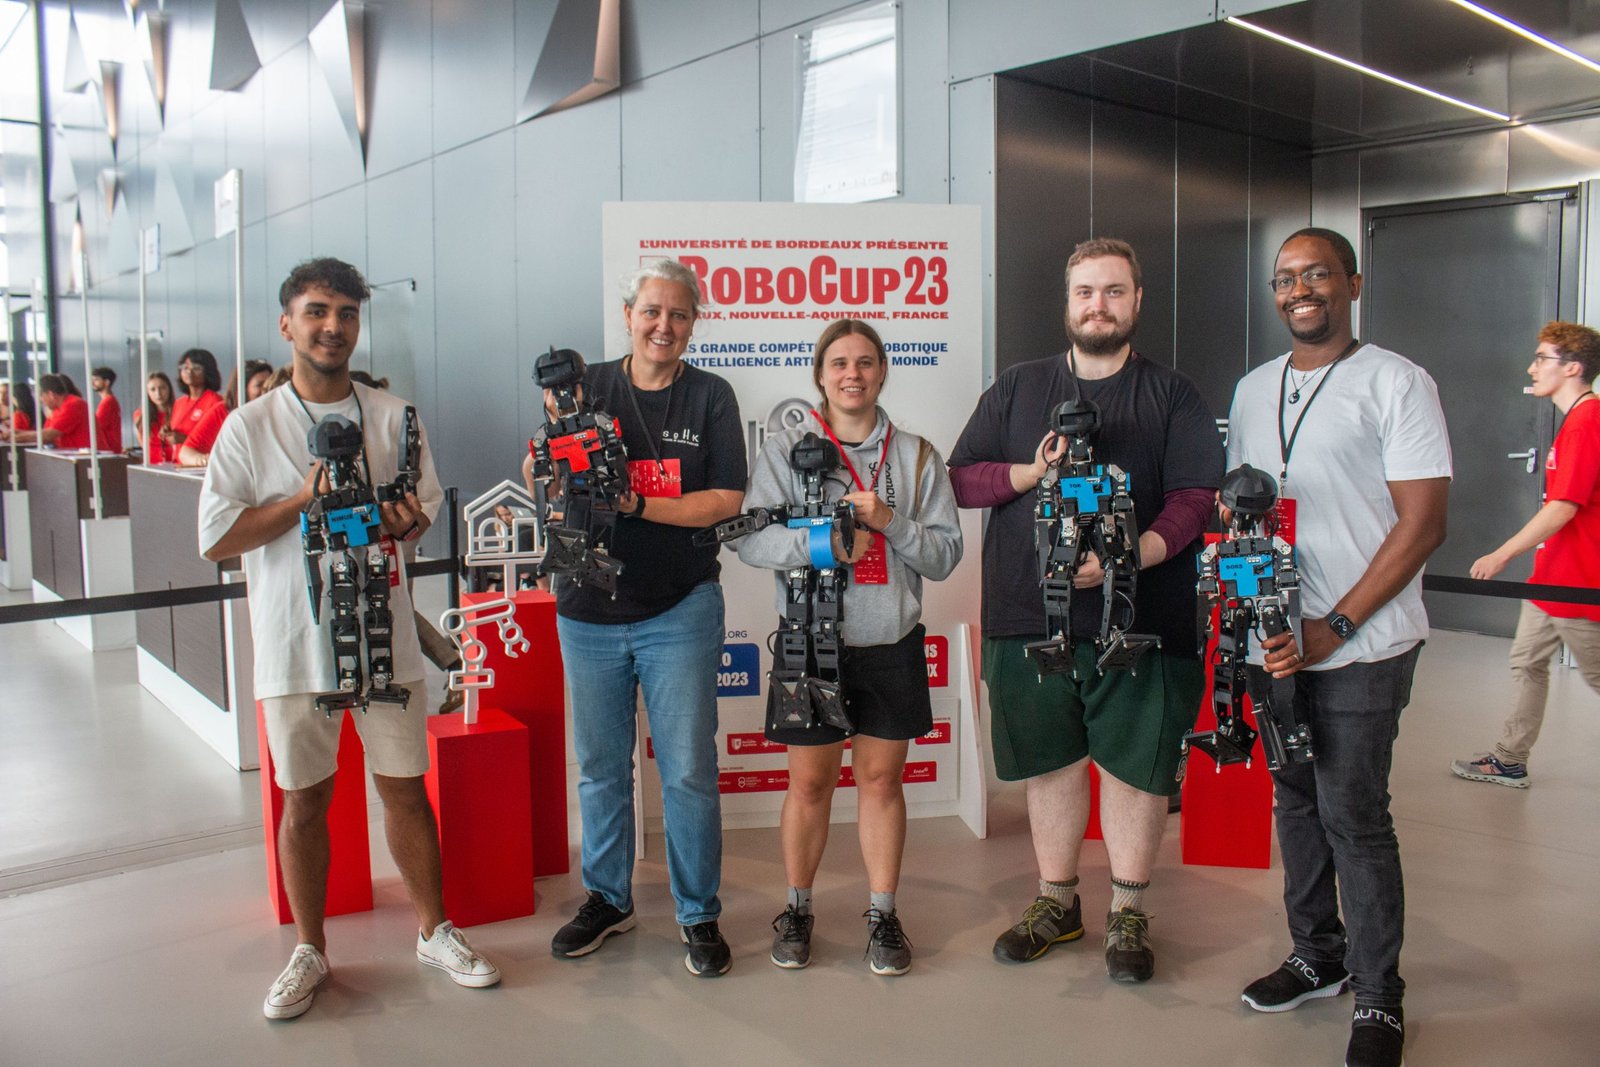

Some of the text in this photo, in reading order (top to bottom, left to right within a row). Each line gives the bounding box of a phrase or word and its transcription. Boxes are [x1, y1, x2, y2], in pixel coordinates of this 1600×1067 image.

[751, 240, 772, 249] DE
[776, 240, 862, 249] BORDEAUX
[866, 238, 949, 250] PRÉSENTE
[729, 311, 890, 321] NOUVELLE-AQUITAINE,
[892, 311, 949, 320] FRANCE
[700, 343, 755, 353] GRANDE
[760, 341, 814, 353] COMPÉT
[884, 343, 948, 354] OBOTIQUE
[892, 356, 938, 366] MONDE
[1286, 956, 1320, 987] UTICA
[1353, 1008, 1402, 1032] AUTICA
